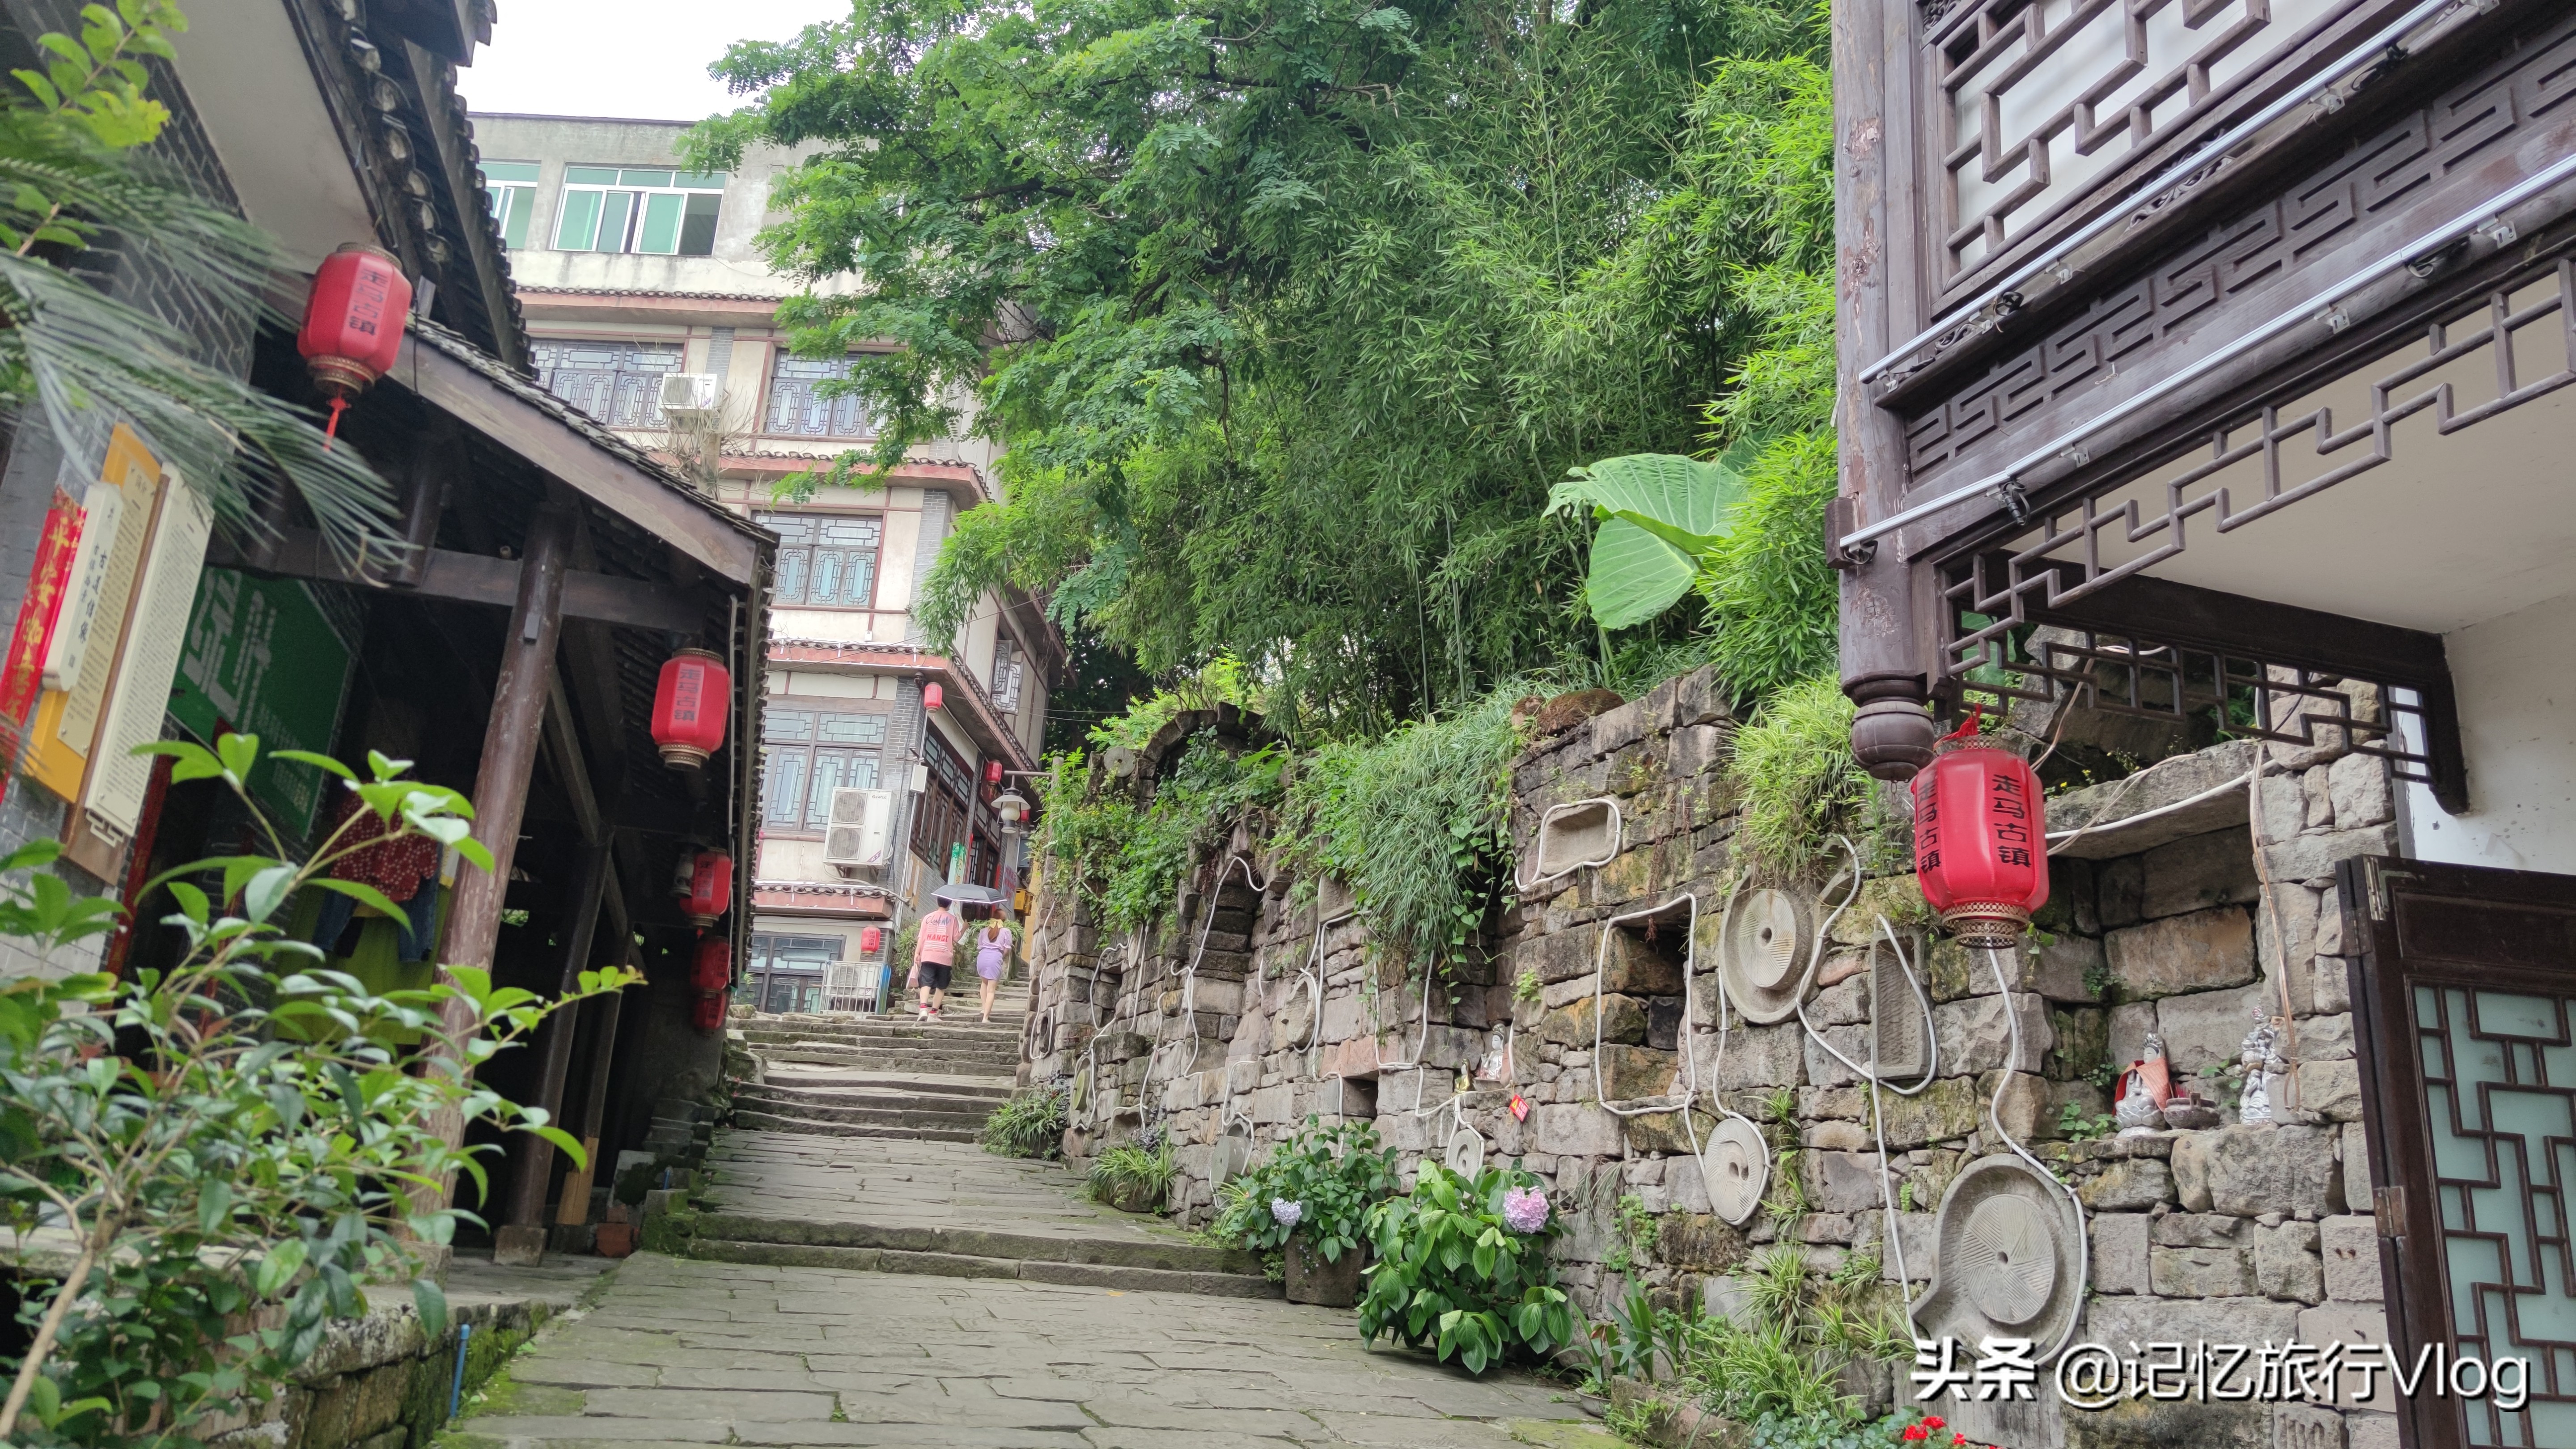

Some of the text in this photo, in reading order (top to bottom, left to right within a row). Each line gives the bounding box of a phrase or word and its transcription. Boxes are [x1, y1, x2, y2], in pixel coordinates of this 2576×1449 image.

[349, 269, 388, 336] 走马古镇
[674, 669, 701, 721] 走马古镇
[1918, 778, 1941, 873] 走马古镇
[1992, 774, 2031, 867] 走马古镇
